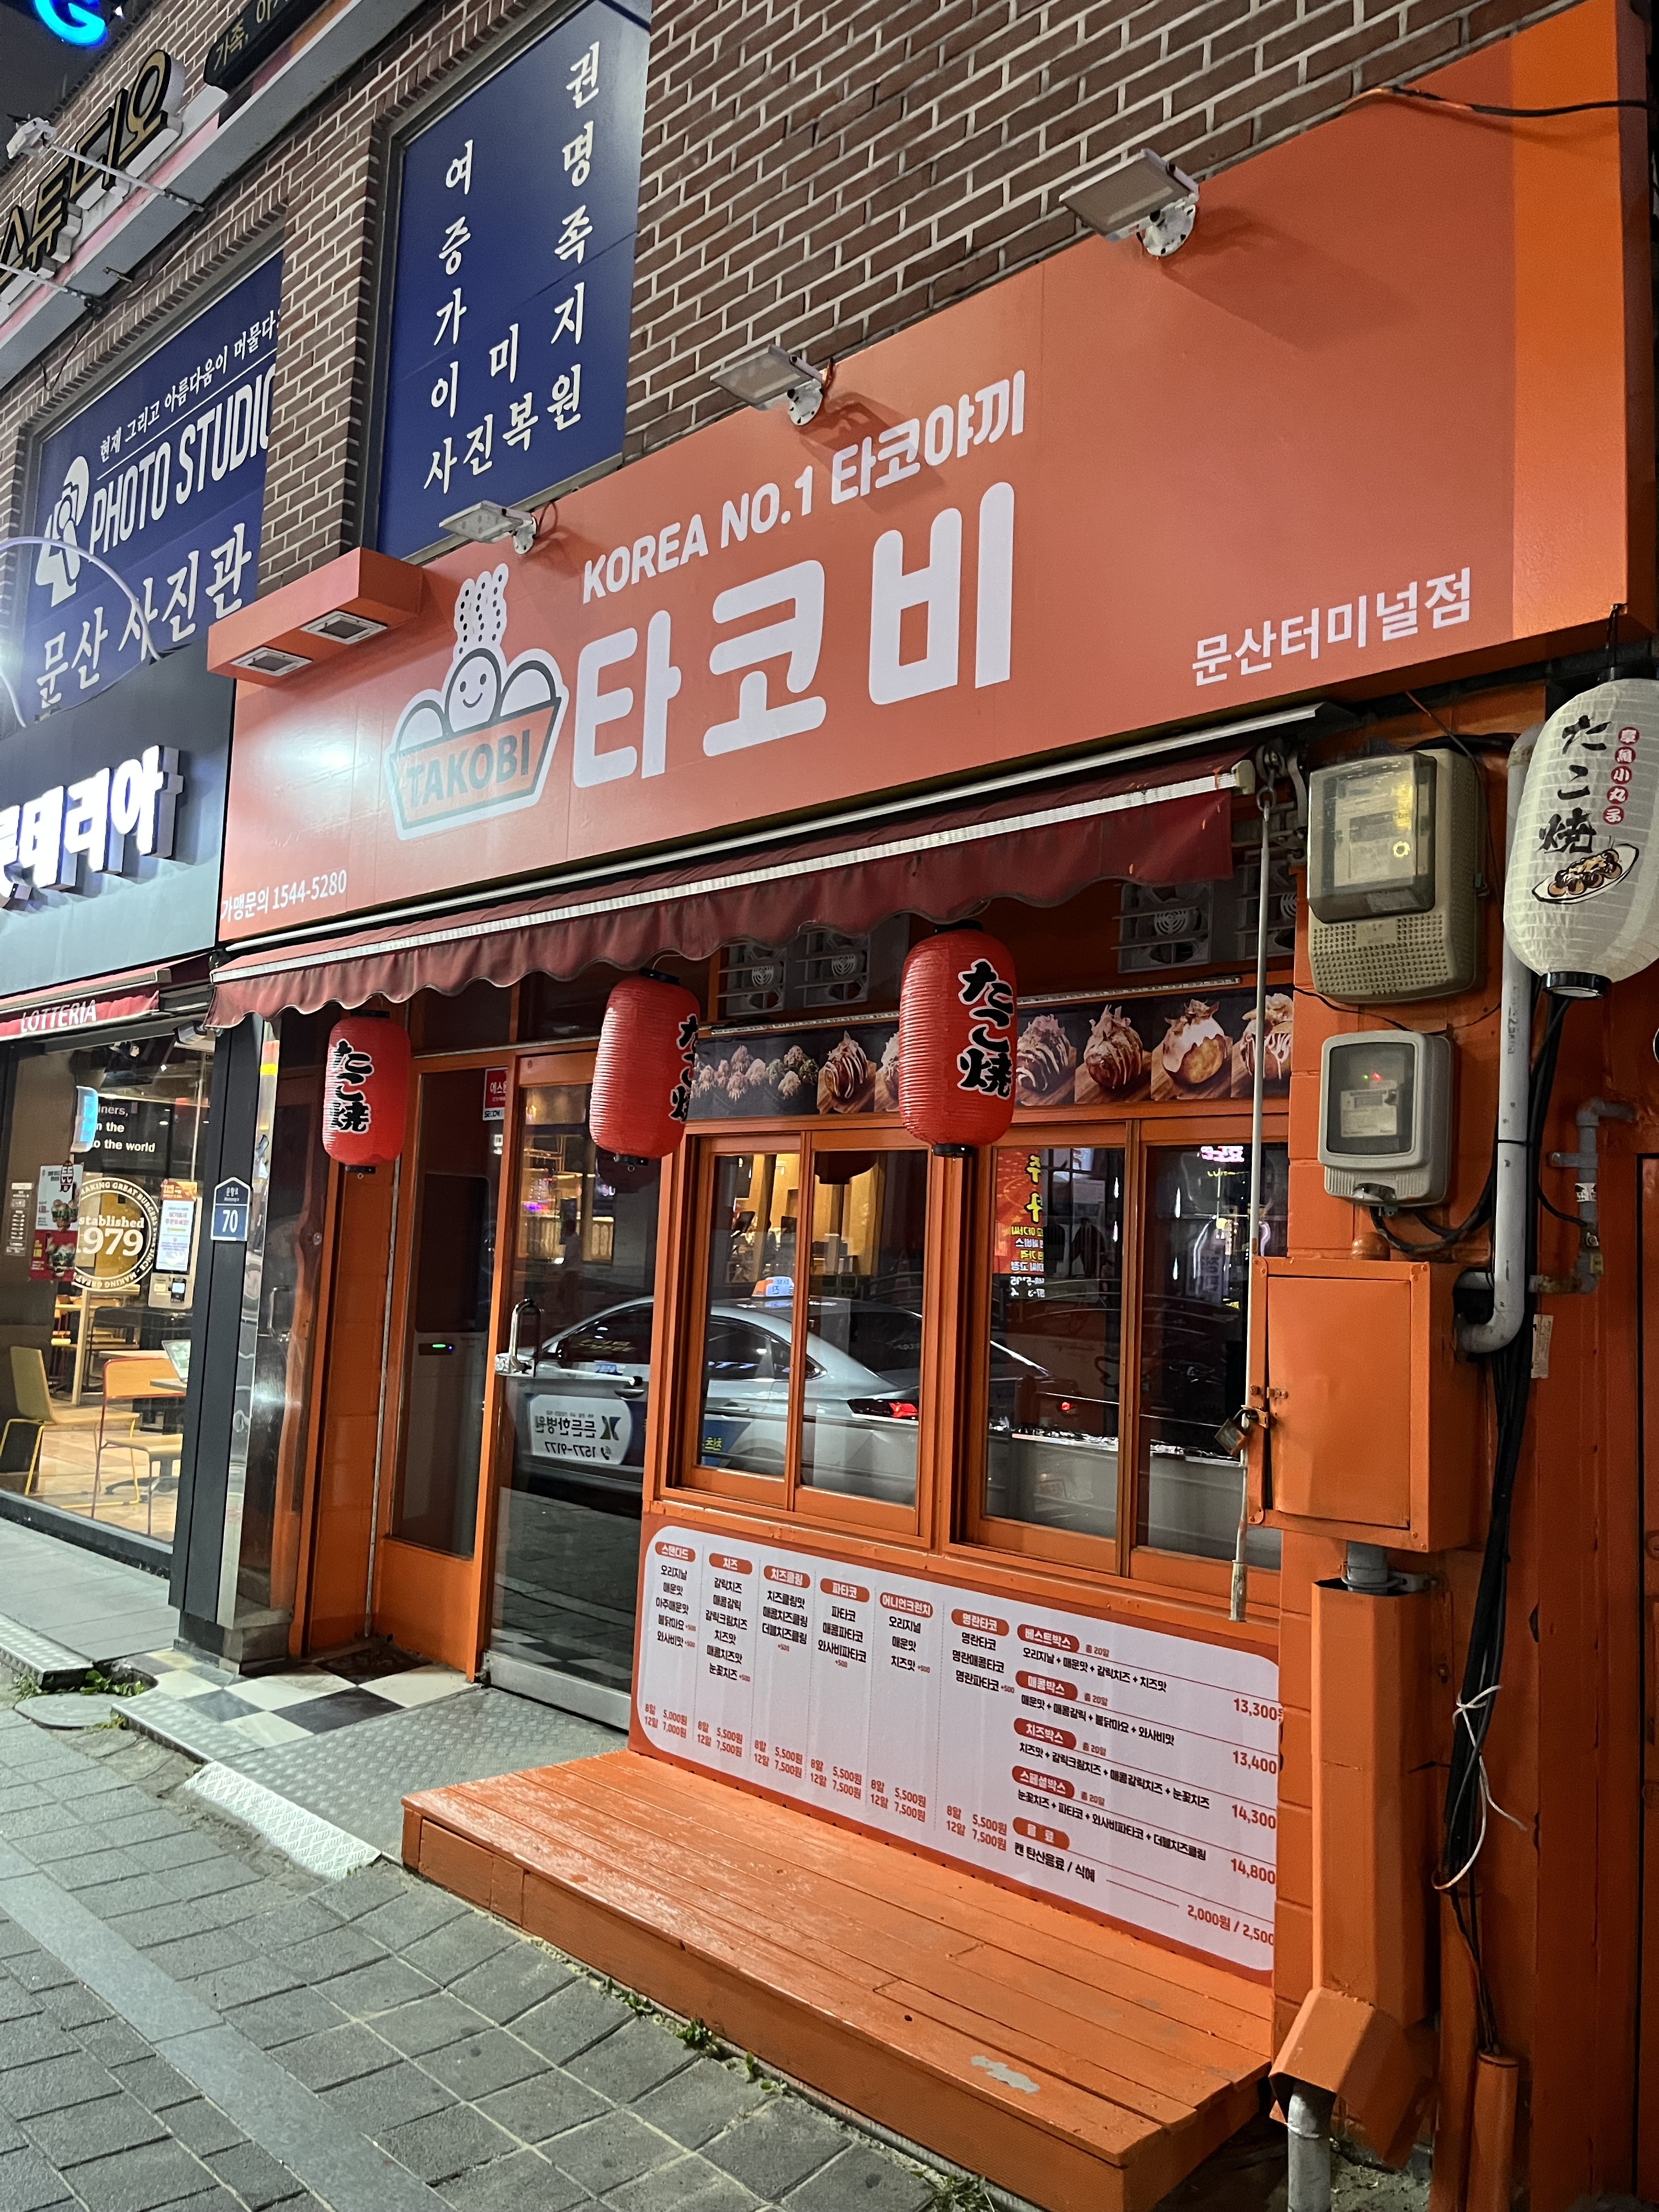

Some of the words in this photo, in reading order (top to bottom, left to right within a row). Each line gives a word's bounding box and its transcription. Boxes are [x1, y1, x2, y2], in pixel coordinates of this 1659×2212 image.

[100, 427, 121, 462] 현재
[125, 400, 160, 442] 그리고
[165, 346, 228, 413] 아름다움이
[234, 310, 280, 360] 머물다
[424, 364, 582, 494] 사진복원
[583, 514, 709, 605] KOREA
[721, 465, 813, 549] NO.1
[831, 370, 1025, 505] 타코야끼
[89, 441, 171, 555] PHOTO
[37, 606, 108, 709] 문산
[118, 522, 252, 662] 사진관
[573, 481, 1015, 788] 타코비
[1192, 566, 1470, 686] 문산터미널점
[405, 727, 531, 810] TAKOBI
[220, 887, 269, 923] 가맹문의
[272, 869, 347, 910] 1544-5280
[20, 999, 97, 1034] LOTTERIA
[957, 959, 1014, 1101] たこ焼
[106, 1122, 125, 1132] the
[104, 1139, 123, 1150] the
[126, 1142, 155, 1153] world
[112, 1182, 138, 1196] GREAT
[78, 1215, 145, 1229] stablished
[222, 1209, 239, 1233] 70
[723, 1557, 738, 1571] 치즈
[663, 1582, 683, 1596] 매운맛
[714, 1577, 742, 1594] 갈릭치즈
[832, 1582, 857, 1599] 파타코
[656, 1597, 689, 1615] 아주매운맛
[713, 1594, 741, 1611] 매콤갈릭
[882, 1594, 930, 1616] 어니언크런치
[658, 1613, 684, 1631] 불닭마요
[706, 1609, 748, 1630] 갈릭크림치즈
[831, 1605, 856, 1622] 파타코
[962, 1613, 997, 1632] 명란타코
[657, 1630, 684, 1648] 와사비맛
[714, 1629, 736, 1645] 치즈맛
[892, 1635, 917, 1652] 매운맛
[962, 1632, 996, 1651] 명란타코
[1025, 1627, 1071, 1649] 베스트박스
[1094, 1646, 1109, 1658] 20알
[707, 1645, 742, 1665] 매콤치즈맛
[817, 1639, 867, 1663] 와사비파타코
[709, 1662, 738, 1680] 눈꽃치즈
[891, 1655, 916, 1672] 치즈맛
[952, 1650, 1005, 1673] 명란매콤타코
[956, 1669, 999, 1692] 명란파타코
[1001, 1685, 1014, 1694] +500
[1063, 1657, 1088, 1673] 매운맛
[1097, 1665, 1131, 1684] 갈릭치즈
[1139, 1676, 1167, 1692] 치즈맛
[1092, 1694, 1108, 1707] 20알
[663, 1709, 687, 1726] 5,000원
[1021, 1694, 1045, 1711] 매운맛
[1053, 1702, 1086, 1722] 매콤갈릭
[1095, 1714, 1129, 1734] 불닭마요
[1138, 1726, 1175, 1746] 와사비맛
[663, 1721, 686, 1739] 7,000원
[716, 1727, 743, 1745] 5,500원
[1025, 1723, 1064, 1744] 치즈박스
[1091, 1743, 1107, 1756] 20알
[716, 1740, 742, 1757] 7,500원
[775, 1746, 803, 1765] 5,500원
[775, 1759, 802, 1779] 7,500원
[832, 1766, 862, 1786] 5,500원
[1019, 1742, 1043, 1759] 치즈맛
[1052, 1751, 1101, 1776] 갈릭크림치즈
[1110, 1769, 1163, 1795] 매콤갈릭치즈
[1172, 1788, 1210, 1809] 눈꽃치즈
[832, 1779, 861, 1799] 7,500원
[895, 1787, 926, 1808] 5,500원
[1089, 1793, 1105, 1807] 20알
[894, 1802, 926, 1822] 7,500원
[1017, 1788, 1049, 1809] 눈꽃치즈
[1058, 1802, 1084, 1820] 파타코
[1092, 1813, 1144, 1841] 와사비파타코
[972, 1814, 1007, 1837] 5,500원
[972, 1829, 1007, 1852] 7,500원
[1015, 1842, 1024, 1857] 캔
[1026, 1846, 1065, 1871] 탄산음료
[1187, 1904, 1231, 1932] 2,000원
